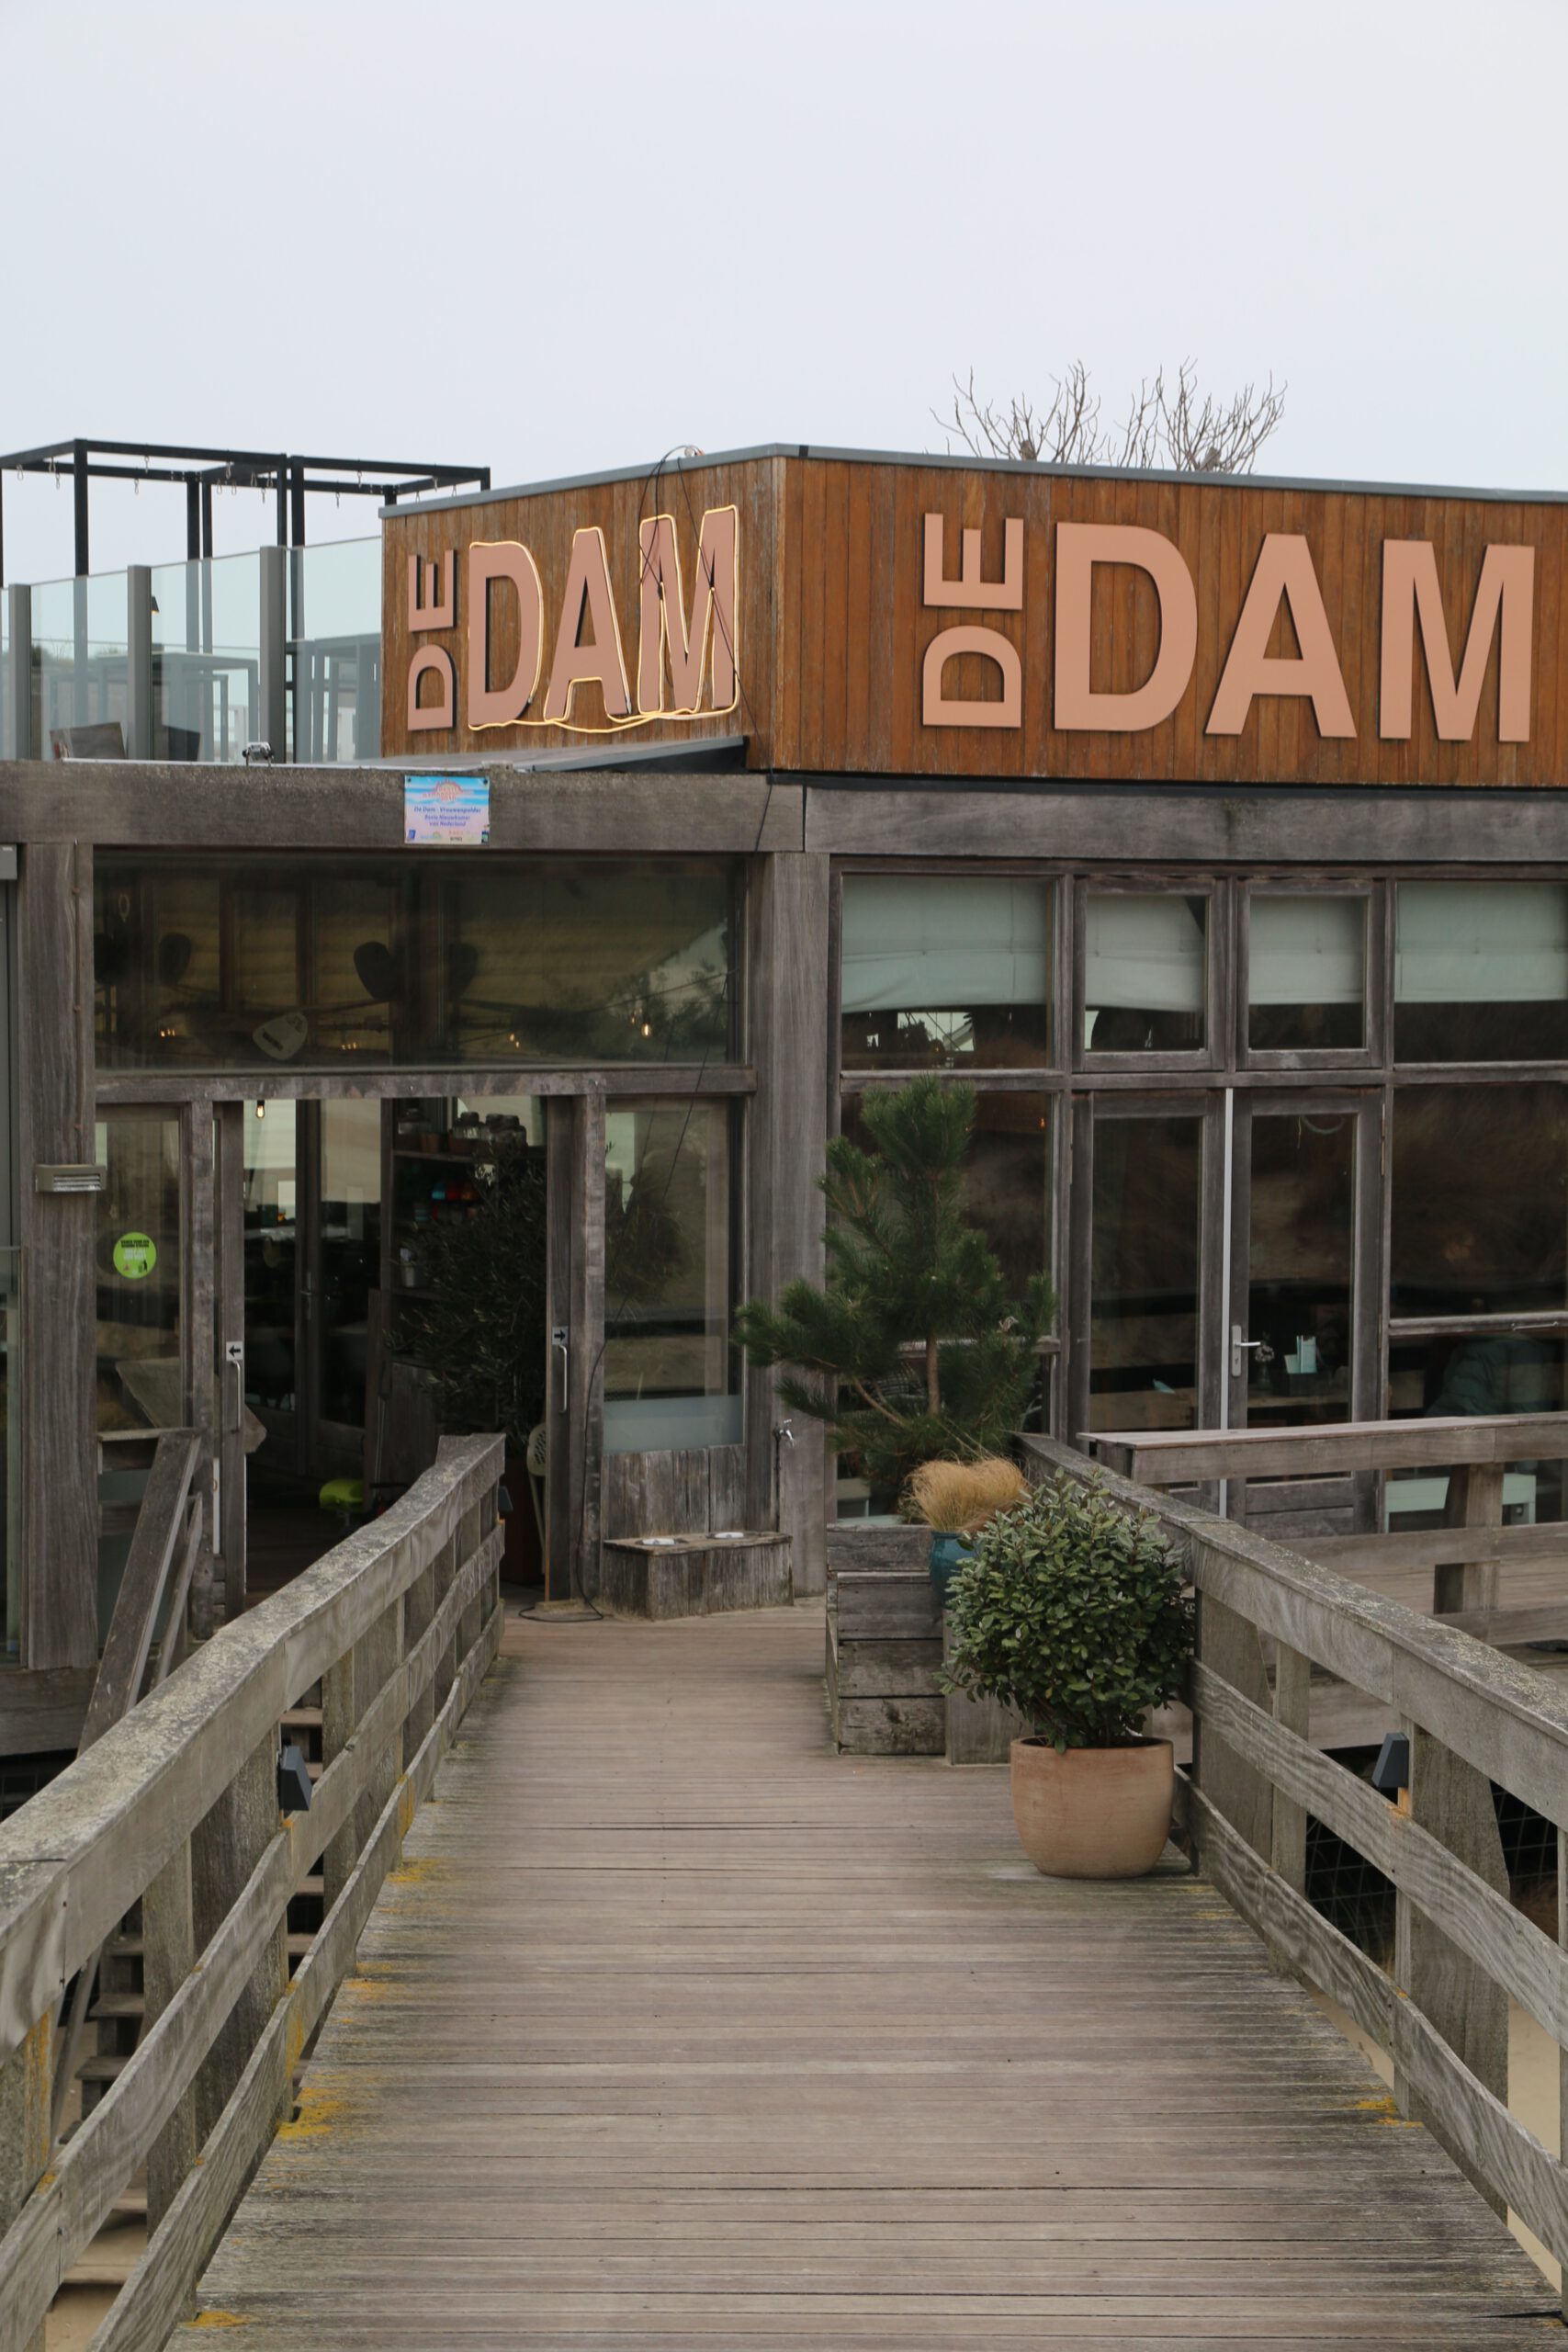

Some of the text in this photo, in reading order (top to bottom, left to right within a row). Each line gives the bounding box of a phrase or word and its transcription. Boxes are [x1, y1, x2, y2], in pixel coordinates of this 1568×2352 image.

[408, 506, 739, 731] DE DAM
[922, 513, 1535, 742] DE DAM
